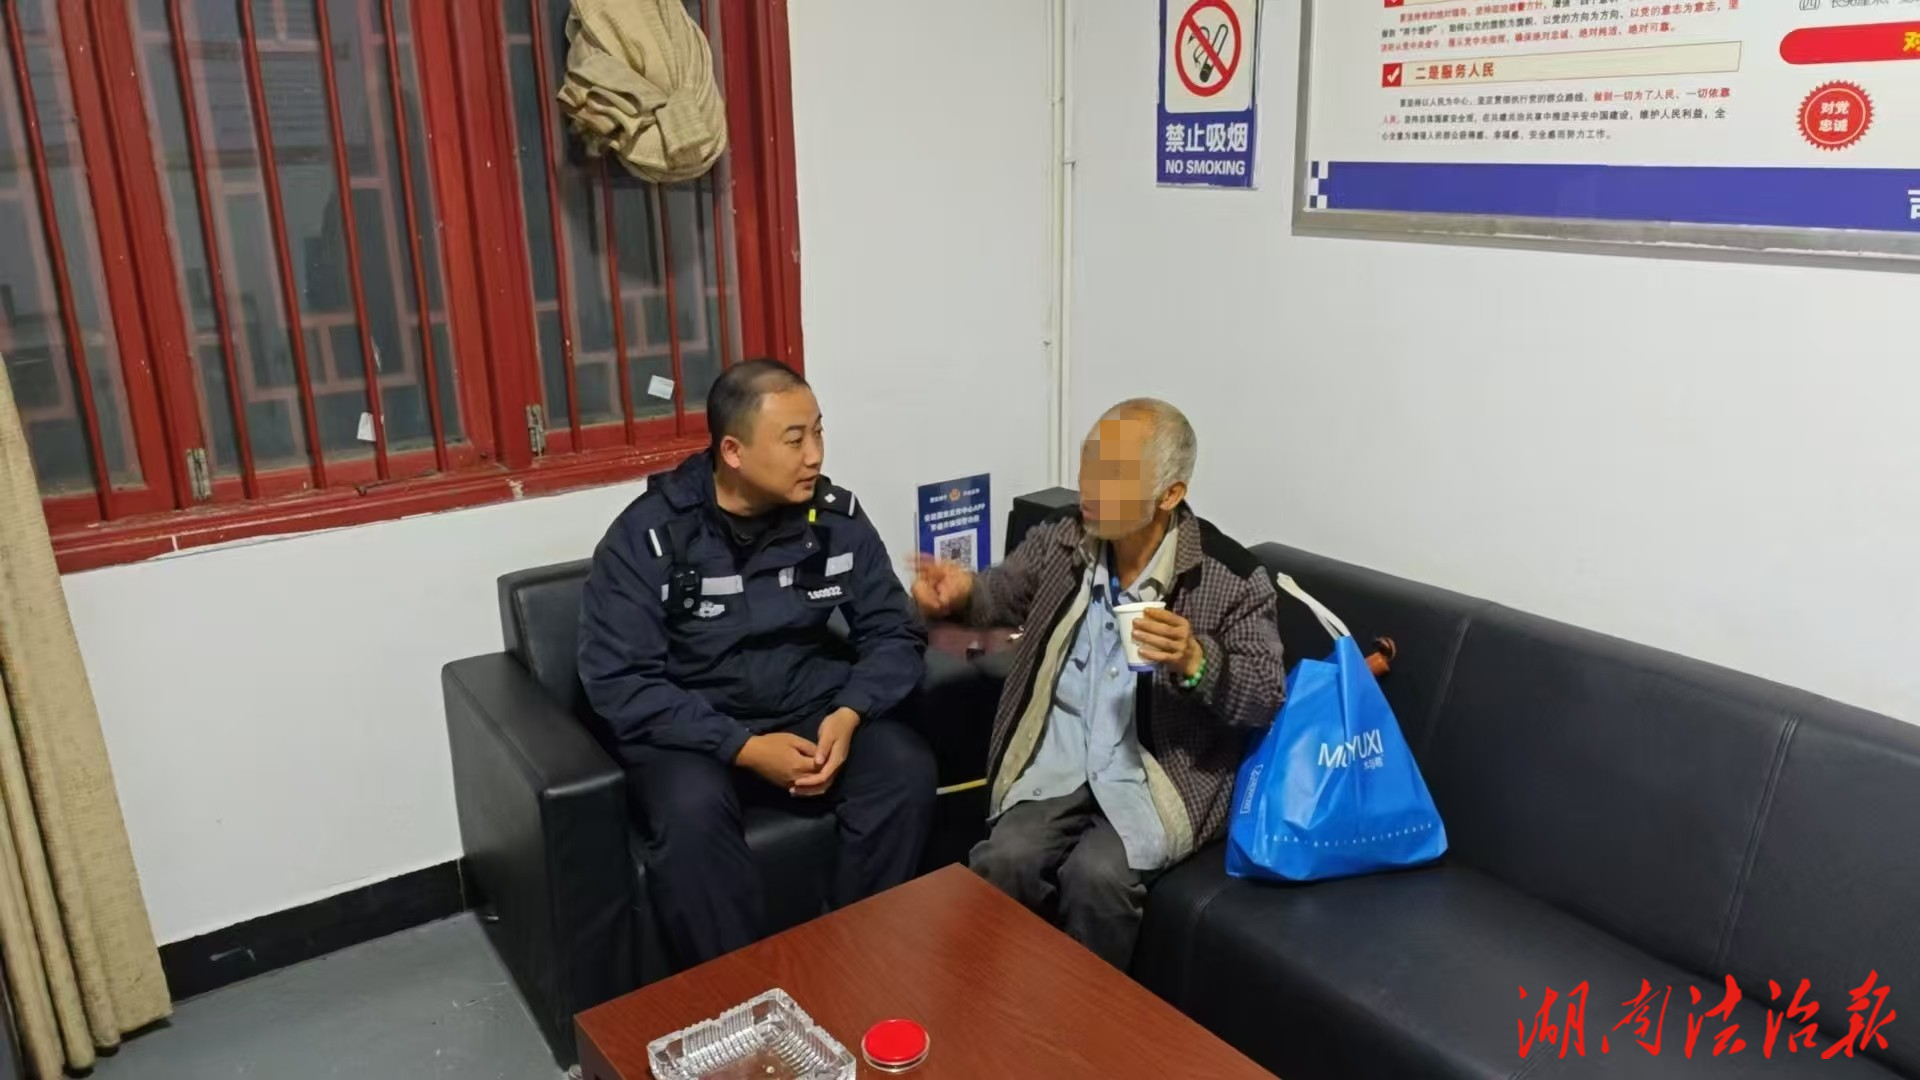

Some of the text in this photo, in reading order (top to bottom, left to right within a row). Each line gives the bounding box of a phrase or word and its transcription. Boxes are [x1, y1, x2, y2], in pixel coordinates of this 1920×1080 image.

[1415, 62, 1494, 80] 二是服务人民
[1820, 101, 1849, 114] 对党
[1818, 118, 1848, 132] 忠诚
[1165, 122, 1248, 152] 禁止吸烟
[1165, 160, 1245, 175] NO SMOKING
